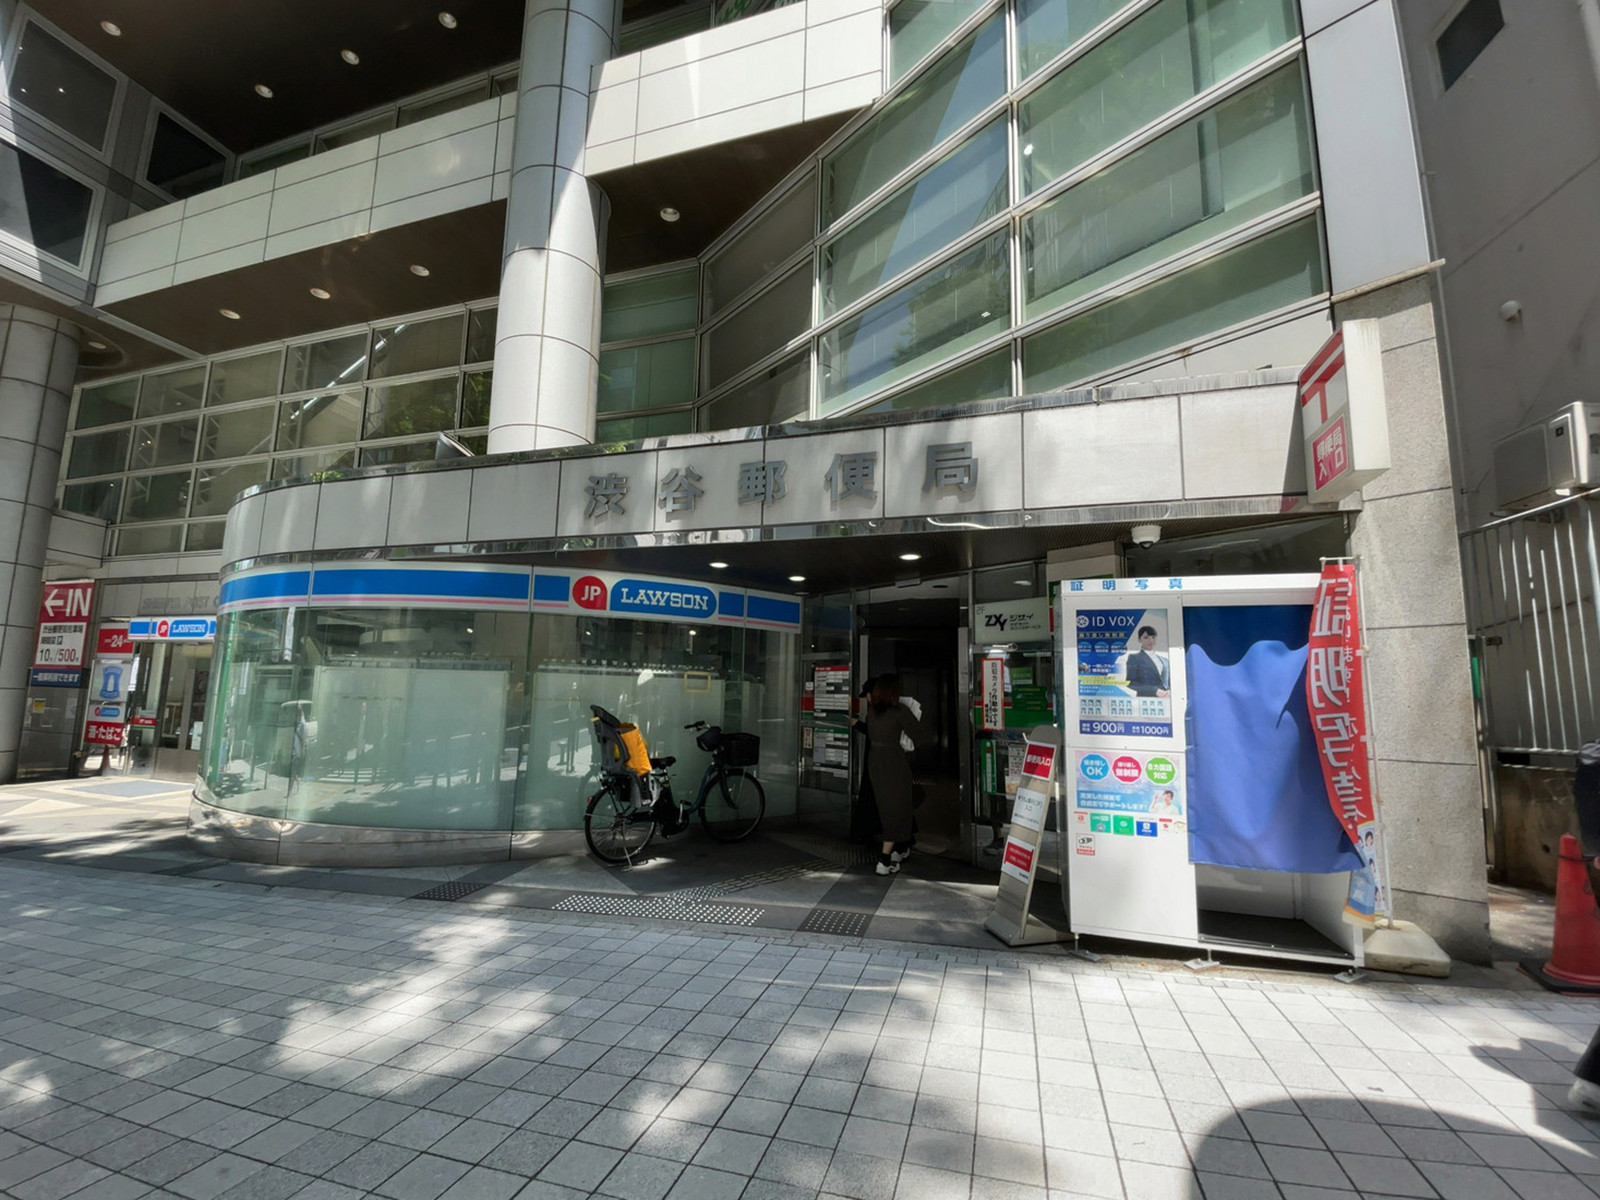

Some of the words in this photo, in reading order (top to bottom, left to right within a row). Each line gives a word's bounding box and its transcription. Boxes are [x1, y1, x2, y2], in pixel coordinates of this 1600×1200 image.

[1316, 426, 1343, 461] 郵便局
[1319, 449, 1345, 481] 入口
[583, 441, 979, 519] 渋谷郵便局
[1070, 578, 1183, 591] 証明写真
[65, 588, 92, 616] IN
[581, 585, 602, 601] JP
[621, 588, 708, 610] LAWSON
[172, 624, 206, 633] LAWSON
[984, 613, 1008, 631] ZXY
[1092, 616, 1106, 626] ID
[1108, 616, 1135, 627] VOX
[110, 635, 123, 648] 24
[1086, 766, 1104, 776] OK
